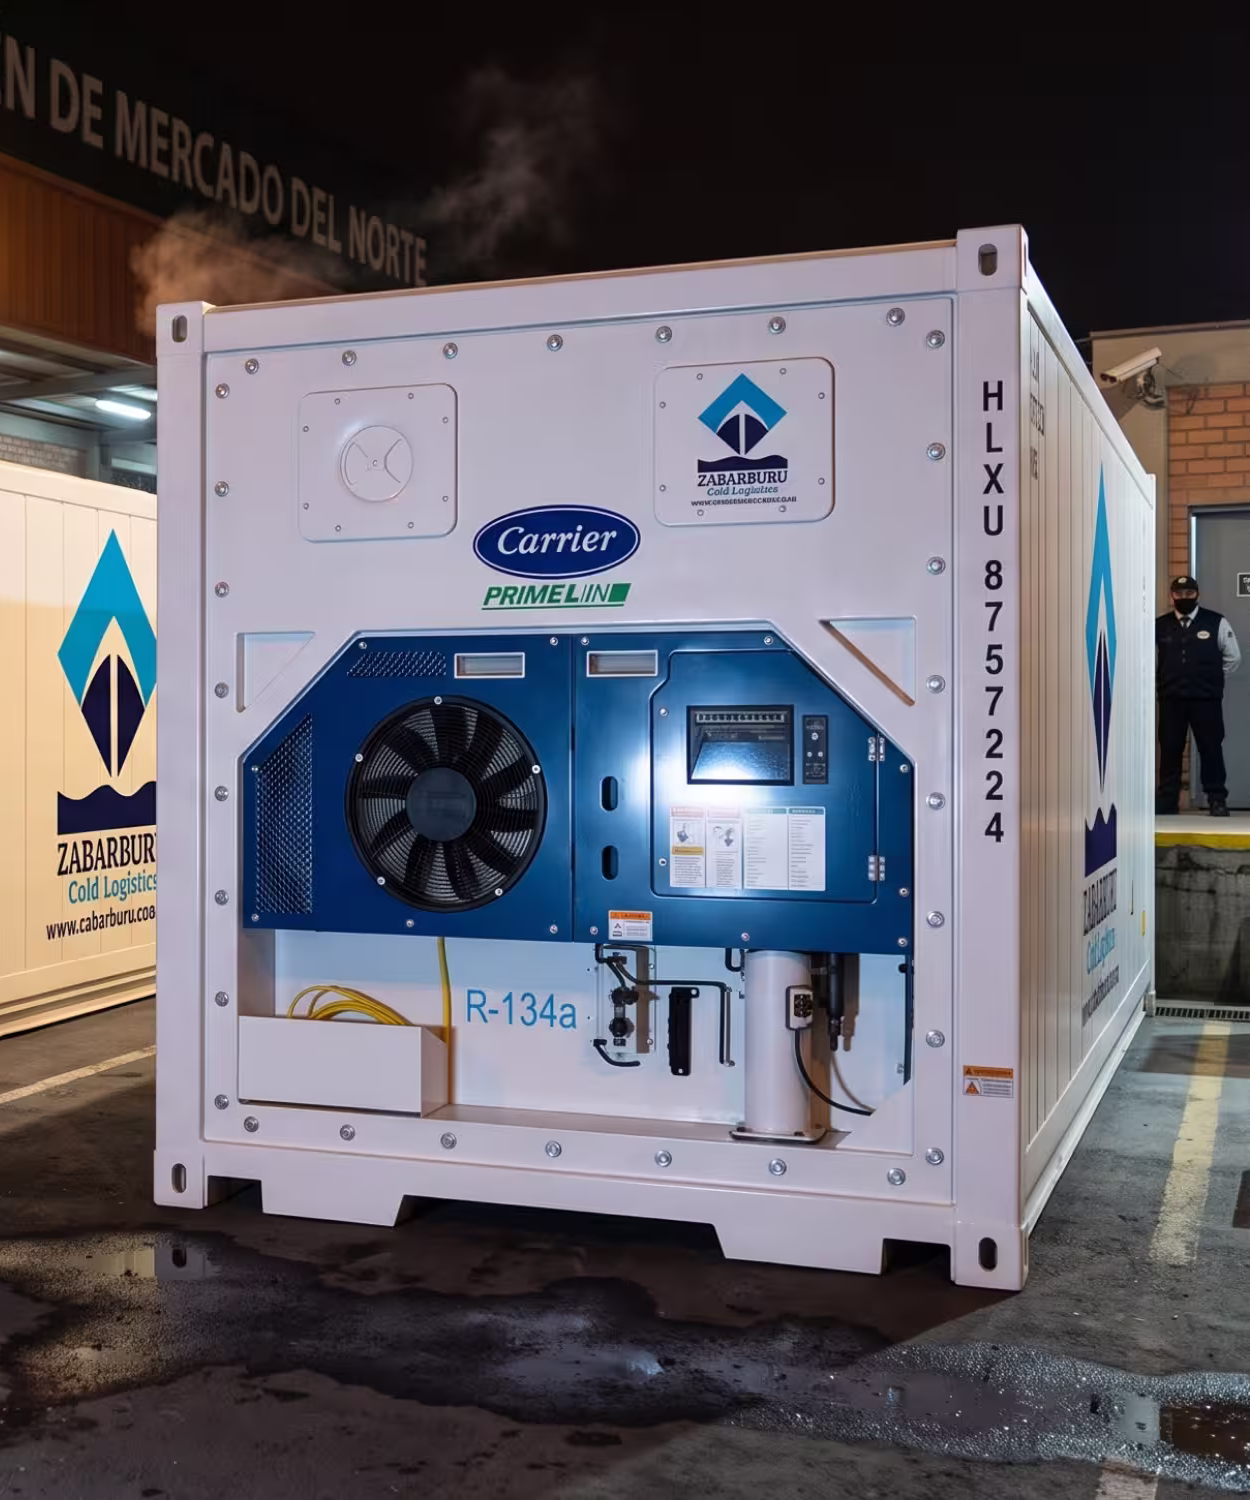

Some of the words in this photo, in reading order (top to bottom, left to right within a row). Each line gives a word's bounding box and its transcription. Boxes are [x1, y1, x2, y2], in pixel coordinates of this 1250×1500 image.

[50, 57, 104, 149] DE
[115, 89, 284, 226] MERCADO
[290, 176, 343, 255] DEL
[349, 204, 428, 287] NORTE
[697, 470, 789, 487] ZABARBURU
[983, 380, 1004, 536] HLXU
[497, 525, 617, 555] Carrier
[984, 559, 1004, 843] 8757224
[57, 832, 157, 876] ZABARBUR
[69, 876, 99, 904] Cold
[466, 989, 577, 1029] R-134a
